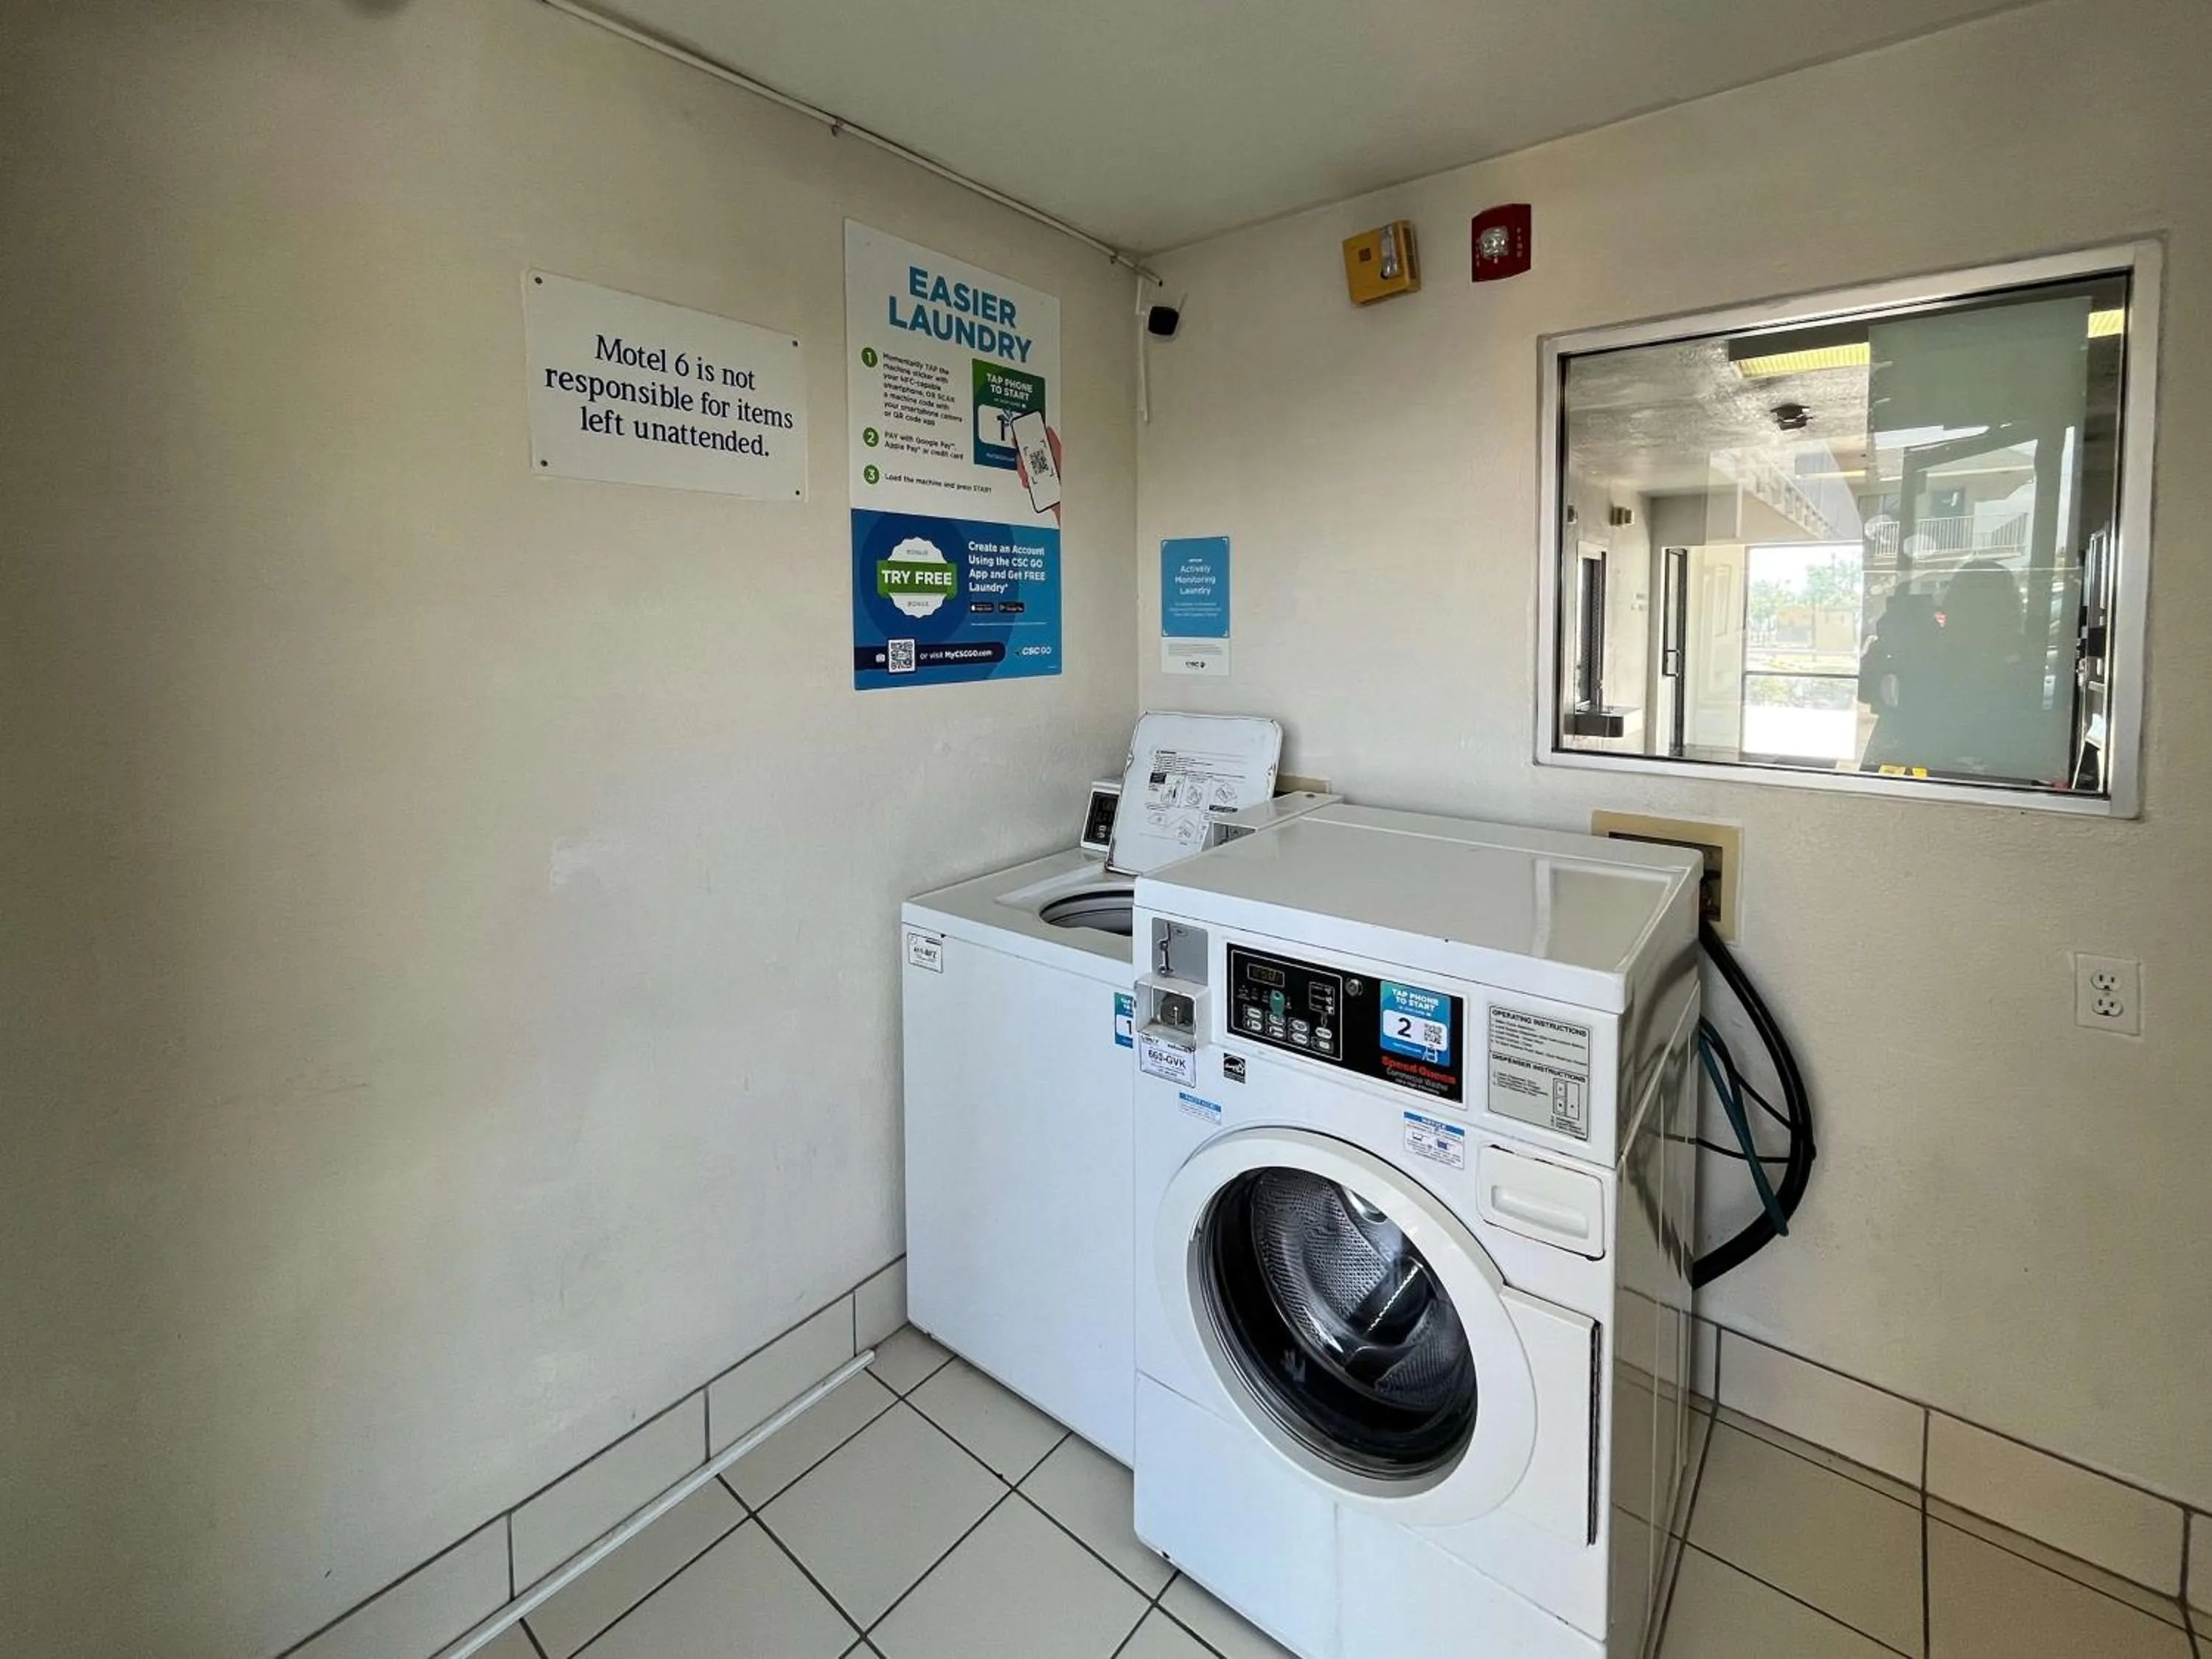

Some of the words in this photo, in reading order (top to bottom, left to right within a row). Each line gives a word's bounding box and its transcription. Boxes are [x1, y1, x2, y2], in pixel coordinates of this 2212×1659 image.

[909, 266, 1016, 328] EASIER
[888, 295, 1032, 363] LAUNDRY
[595, 334, 667, 373] Motel
[674, 353, 690, 377] 6
[697, 357, 714, 382] is
[722, 367, 756, 390] not
[883, 364, 911, 375] machine
[913, 371, 933, 379] sticker
[986, 372, 1003, 383] TAP
[1005, 378, 1032, 393] PHONE
[545, 368, 693, 411] responsible
[701, 392, 730, 418] for
[737, 398, 793, 428] items
[890, 393, 917, 403] machine
[919, 399, 933, 407] code
[990, 384, 1002, 394] TO
[1004, 388, 1029, 401] START
[905, 415, 921, 424] code
[580, 406, 625, 437] left
[633, 420, 769, 456] unattended.
[885, 431, 897, 440] PAY
[915, 437, 939, 447] Google
[885, 440, 904, 450] Apple
[885, 473, 902, 481] Load
[916, 478, 942, 487] machine
[968, 540, 998, 552] Create
[999, 545, 1010, 553] an
[1012, 545, 1045, 556] Account
[968, 554, 995, 567] Using
[996, 557, 1009, 566] the
[1012, 557, 1029, 567] CSC
[1030, 558, 1043, 568] GO
[881, 569, 911, 584] TRY
[915, 571, 952, 585] FREE
[969, 568, 988, 580] App
[990, 570, 1006, 579] and
[1008, 570, 1022, 580] Get
[1024, 571, 1046, 580] FREE
[1175, 577, 1216, 585] Monitoring
[1180, 587, 1211, 596] Laundry
[945, 649, 993, 660] MyCSCGO.com
[1022, 647, 1040, 655] CSC
[1392, 988, 1408, 998] TAP
[1409, 992, 1439, 1006] PHONE
[1396, 996, 1408, 1004] TO
[1409, 1000, 1436, 1012] START
[1126, 1020, 1132, 1035] 1
[1397, 1017, 1412, 1038] 2
[1492, 1009, 1531, 1024] OPERATING
[1534, 1018, 1587, 1037] INSTRUCTIONS
[1381, 1055, 1416, 1073] Speed
[1418, 1065, 1457, 1085] Queen
[1492, 1054, 1531, 1068] DISPENSER
[1533, 1064, 1586, 1083] INSTRUCTIONS
